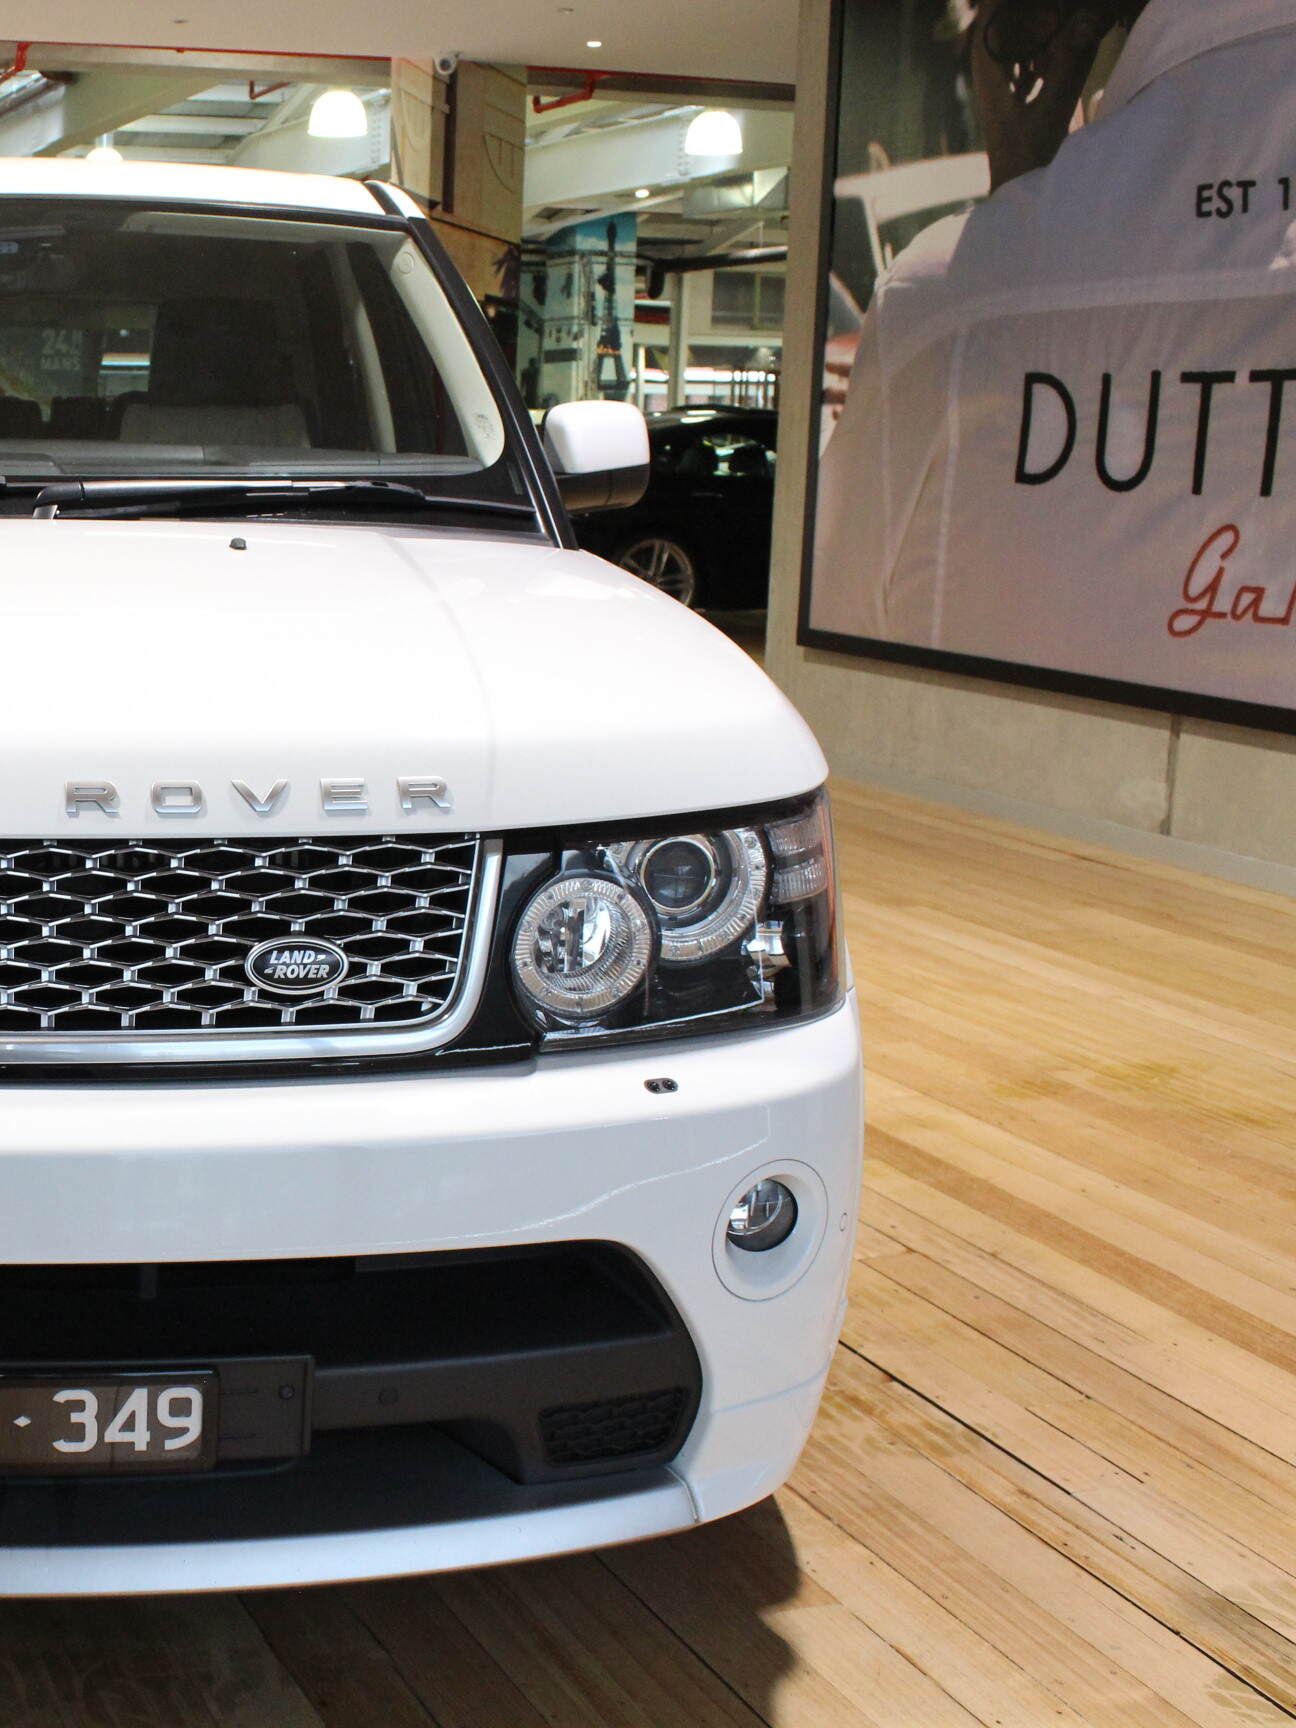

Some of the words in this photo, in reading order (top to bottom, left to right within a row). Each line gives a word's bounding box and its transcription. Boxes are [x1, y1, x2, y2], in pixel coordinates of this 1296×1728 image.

[1196, 179, 1257, 219] EST
[1015, 368, 1296, 498] DUTT
[64, 774, 453, 816] ROVER
[269, 949, 316, 964] LAND
[273, 963, 330, 979] ROVER
[52, 1386, 204, 1453] 349
